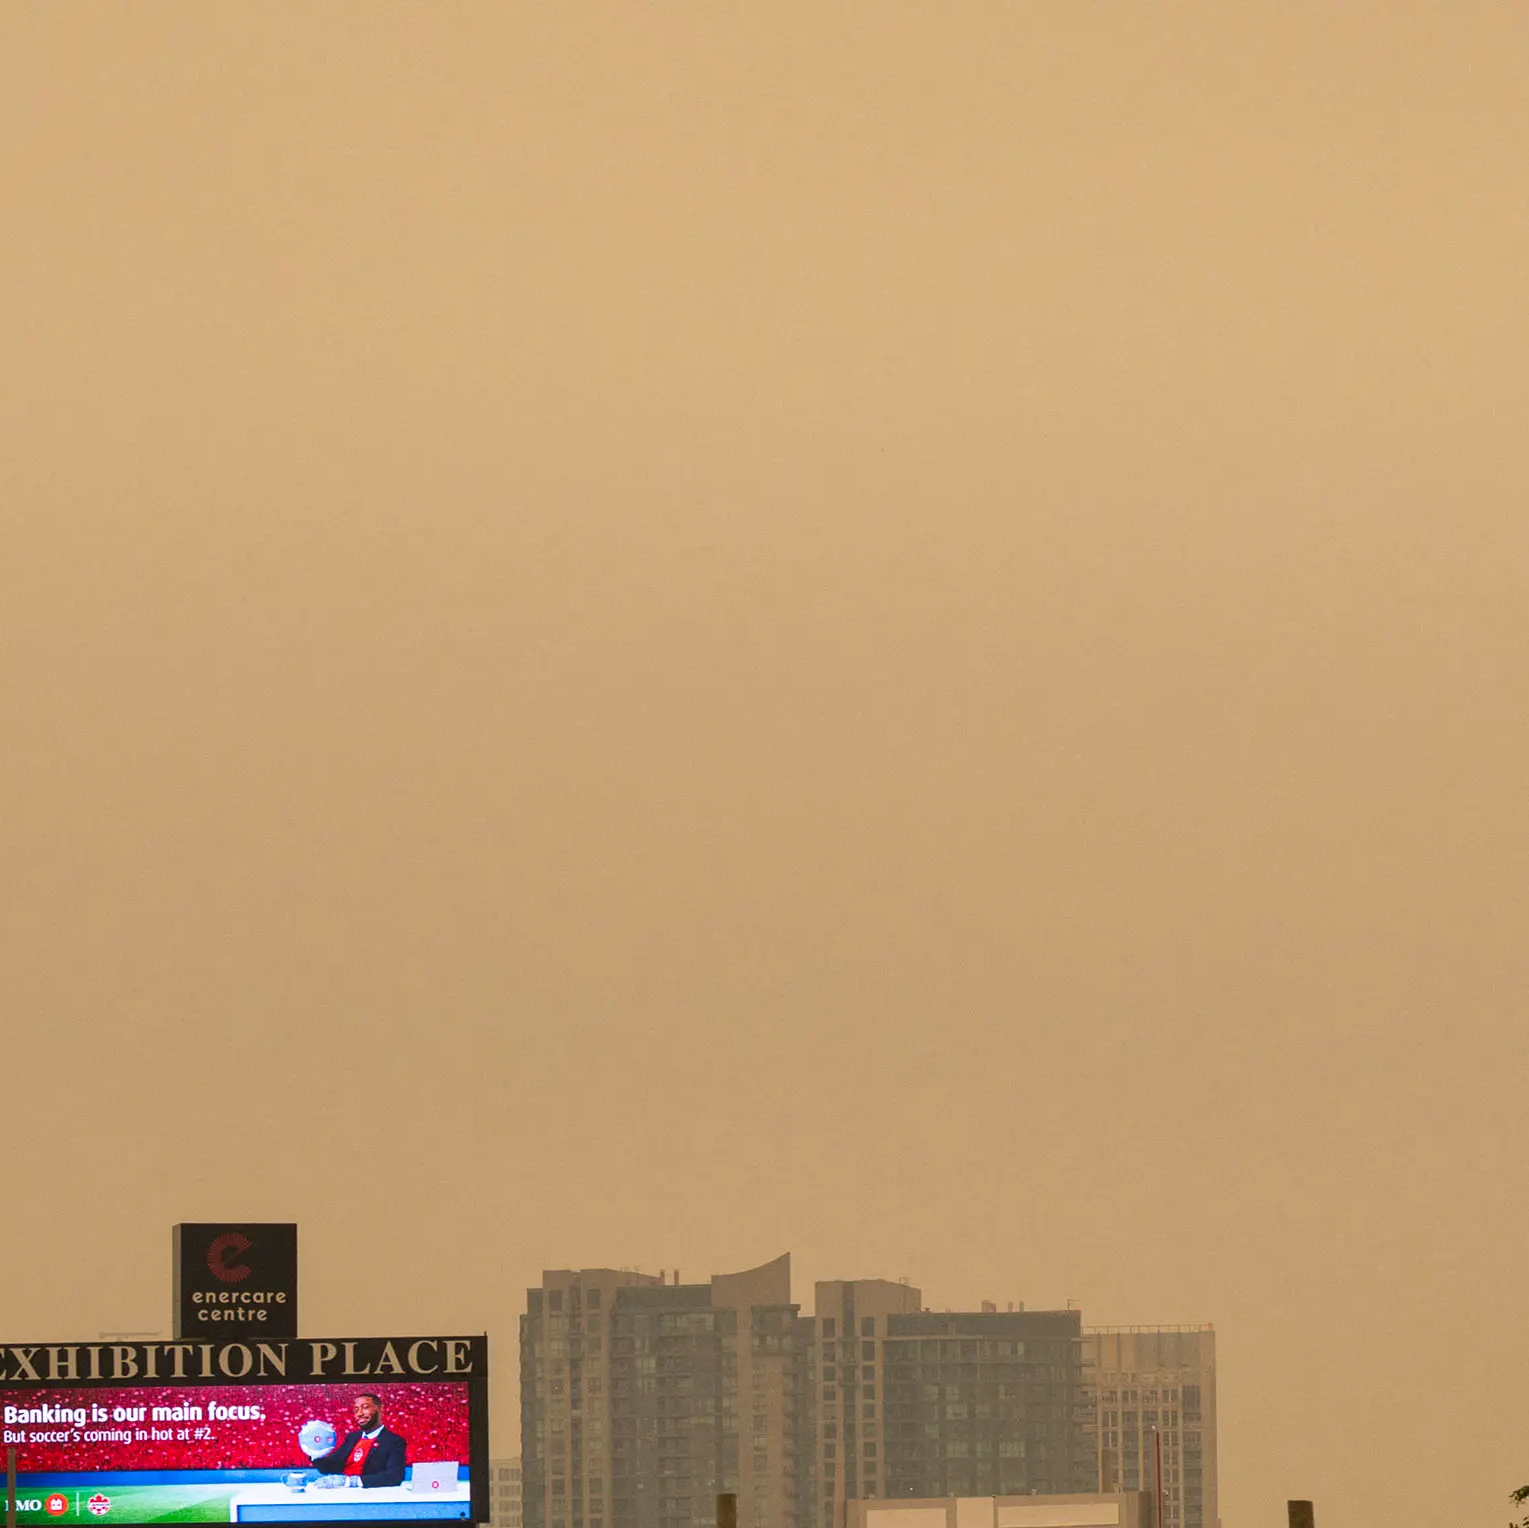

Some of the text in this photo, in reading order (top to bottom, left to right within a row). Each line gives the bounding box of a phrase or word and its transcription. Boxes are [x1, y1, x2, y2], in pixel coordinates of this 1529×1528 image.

[192, 1291, 287, 1304] enercare
[198, 1308, 268, 1321] centre
[309, 1340, 473, 1376] PLACE
[4, 1404, 86, 1427] Banking
[91, 1404, 108, 1423] is
[113, 1407, 146, 1423] our
[152, 1402, 202, 1422] main
[3, 1430, 26, 1443] But
[83, 1429, 131, 1444] coming
[135, 1428, 148, 1440] in
[151, 1427, 173, 1441] hot
[176, 1428, 190, 1440] at
